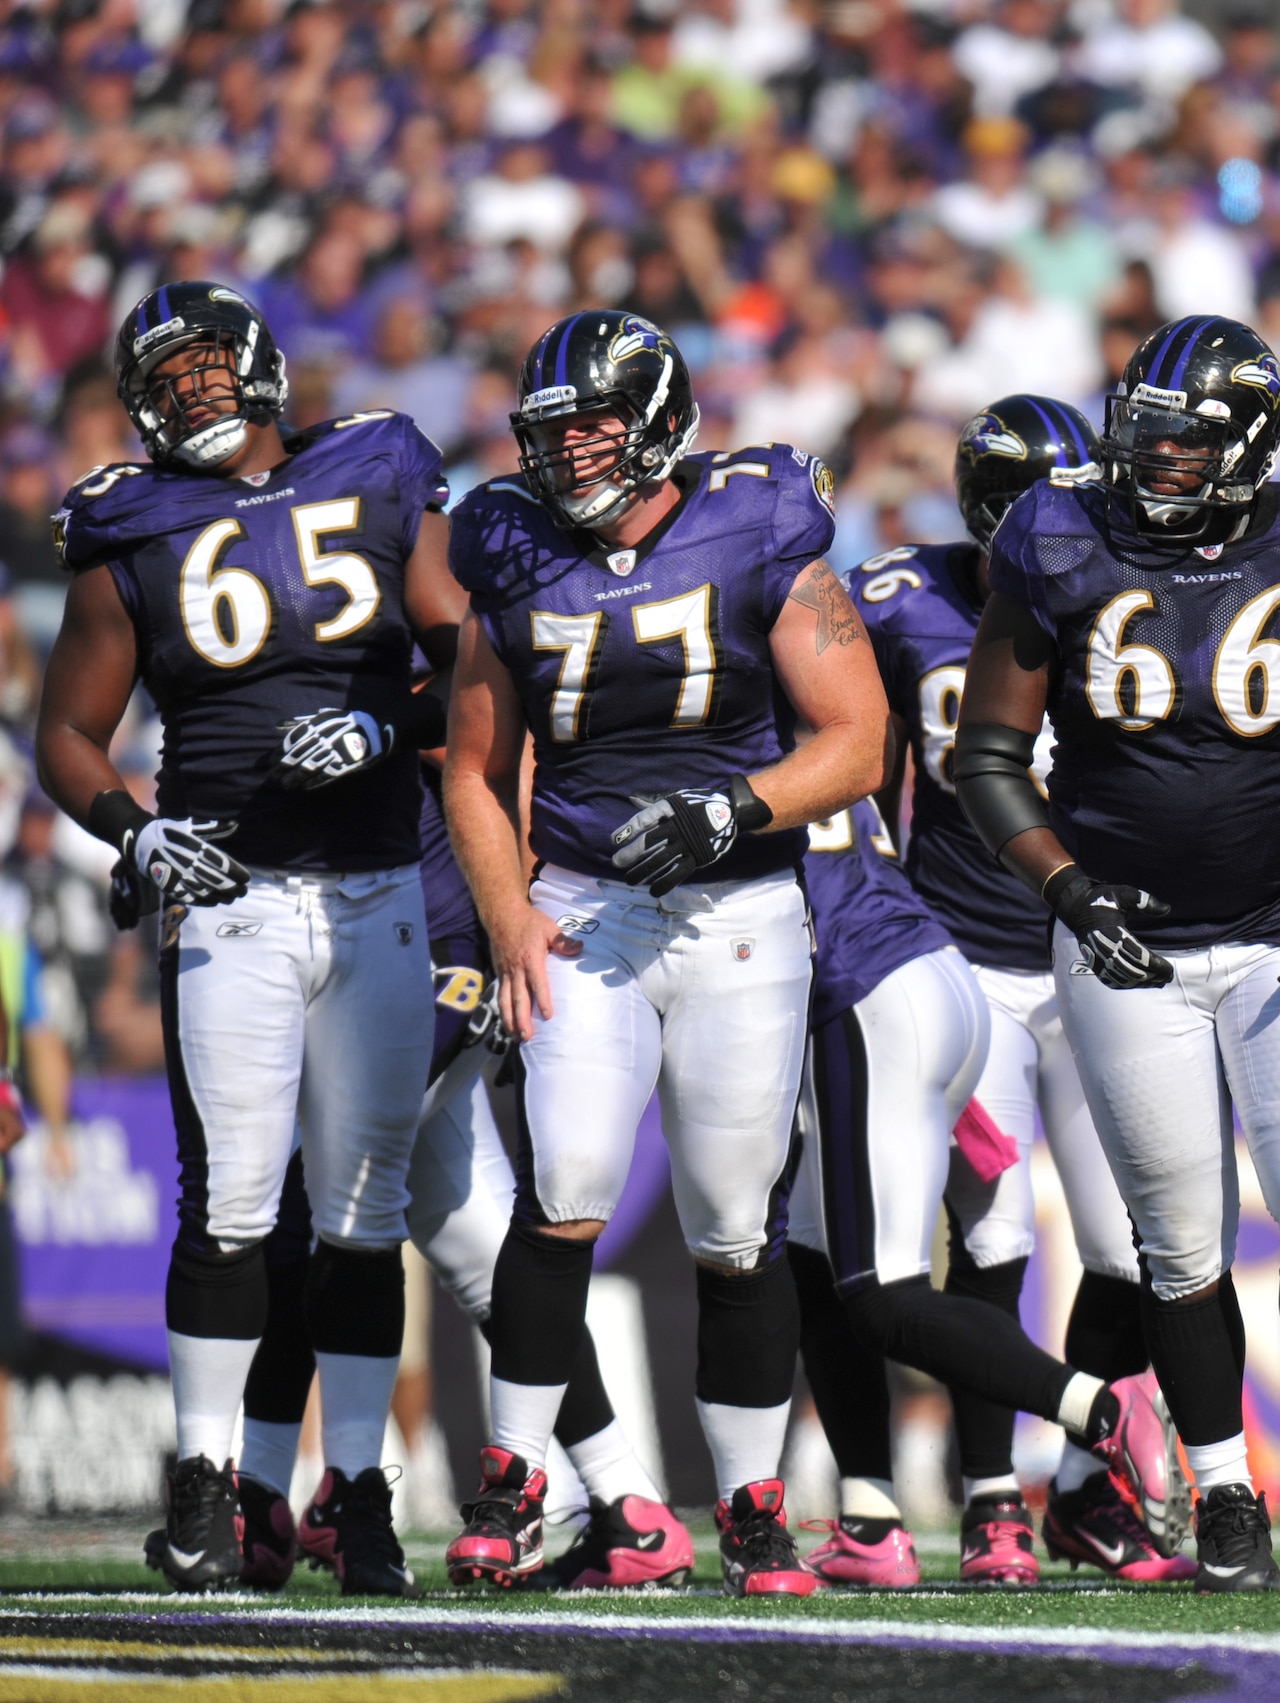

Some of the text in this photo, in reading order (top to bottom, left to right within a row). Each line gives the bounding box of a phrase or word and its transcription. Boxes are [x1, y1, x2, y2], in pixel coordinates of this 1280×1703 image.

[534, 388, 563, 404] Riddell
[1146, 391, 1174, 402] Riddell
[234, 487, 295, 508] RAVENS
[179, 496, 381, 668] 65
[1171, 570, 1243, 584] RAVENS
[594, 581, 652, 602] RAVENS
[529, 582, 717, 743] 77
[431, 966, 484, 1013] B
